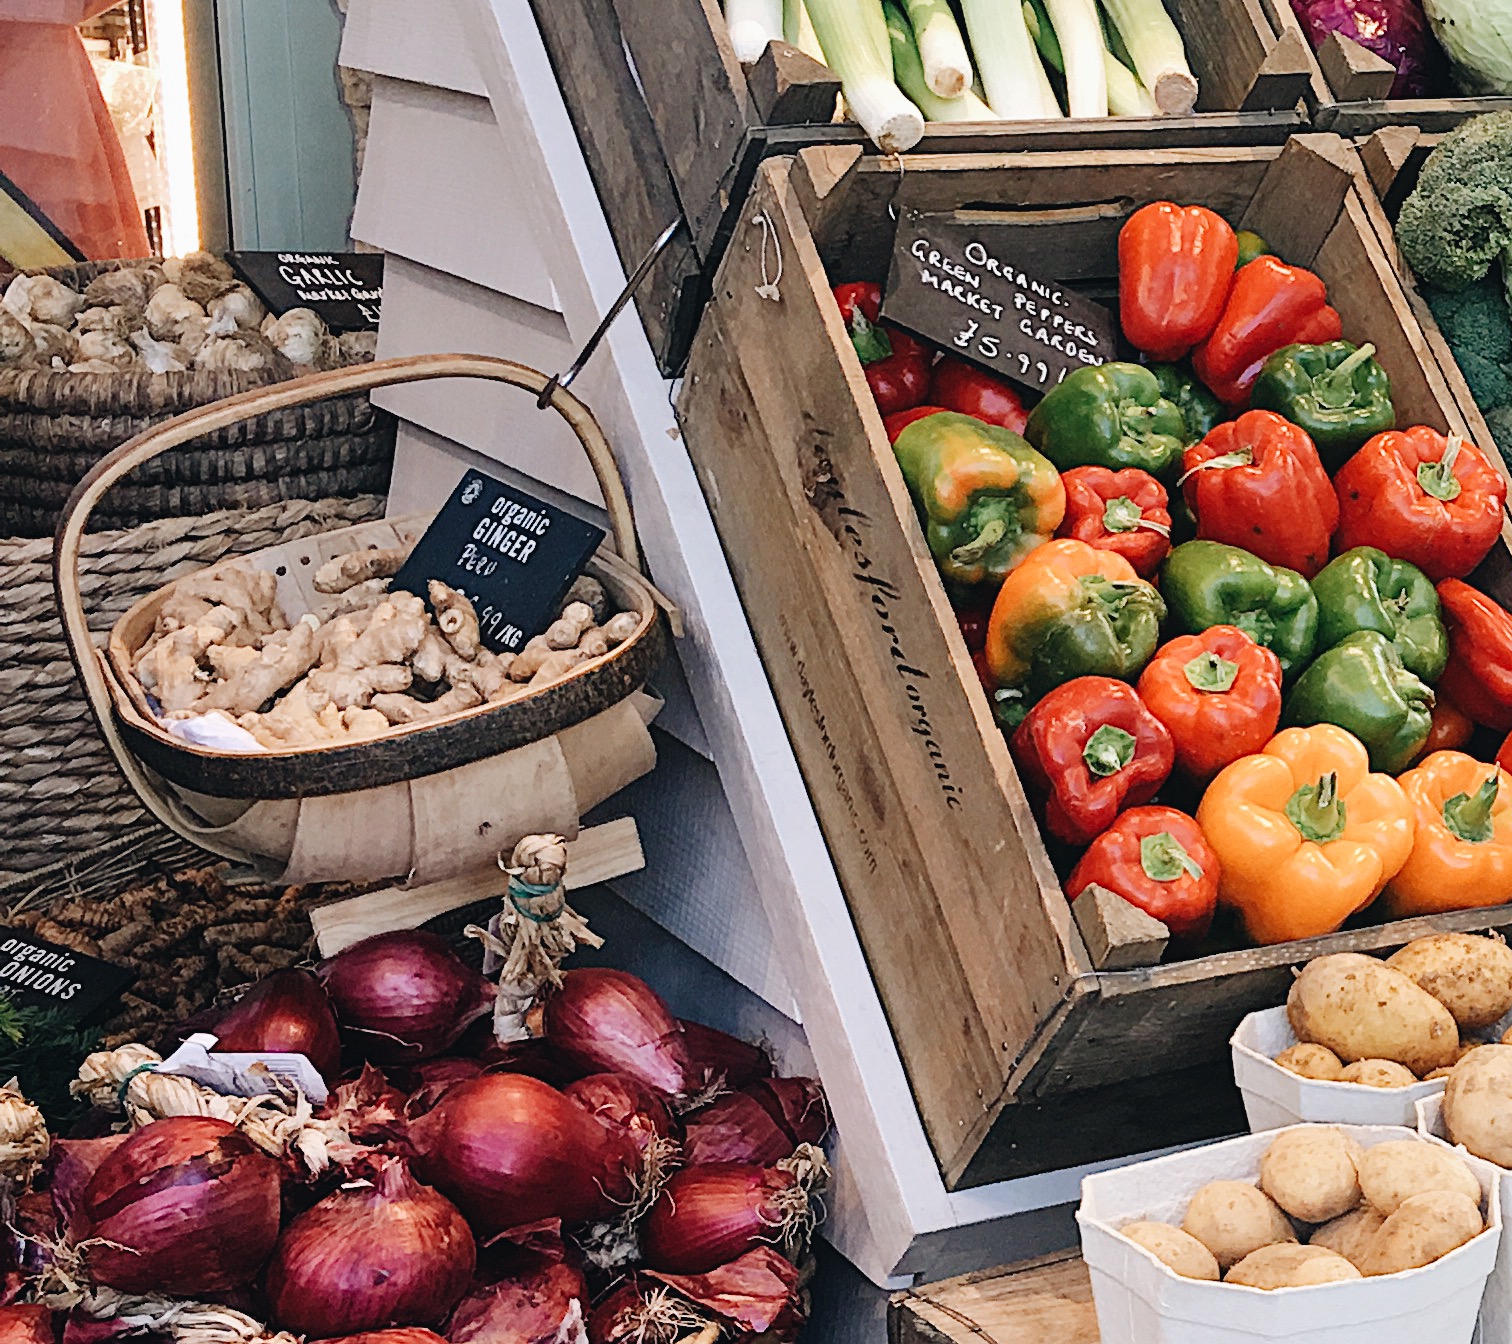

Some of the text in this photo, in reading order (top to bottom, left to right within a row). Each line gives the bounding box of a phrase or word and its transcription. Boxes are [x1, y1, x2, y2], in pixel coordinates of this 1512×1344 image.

[277, 253, 339, 265] ORGANIC
[279, 265, 363, 288] GARLIC
[911, 239, 1098, 346] GREEN PEPPERS
[921, 269, 1103, 367] MARKET GARDEN
[491, 496, 550, 536] organic
[472, 517, 536, 564] GINGER
[906, 683, 965, 812] organic
[0, 938, 76, 972] organic
[0, 961, 82, 1000] ONIONS
